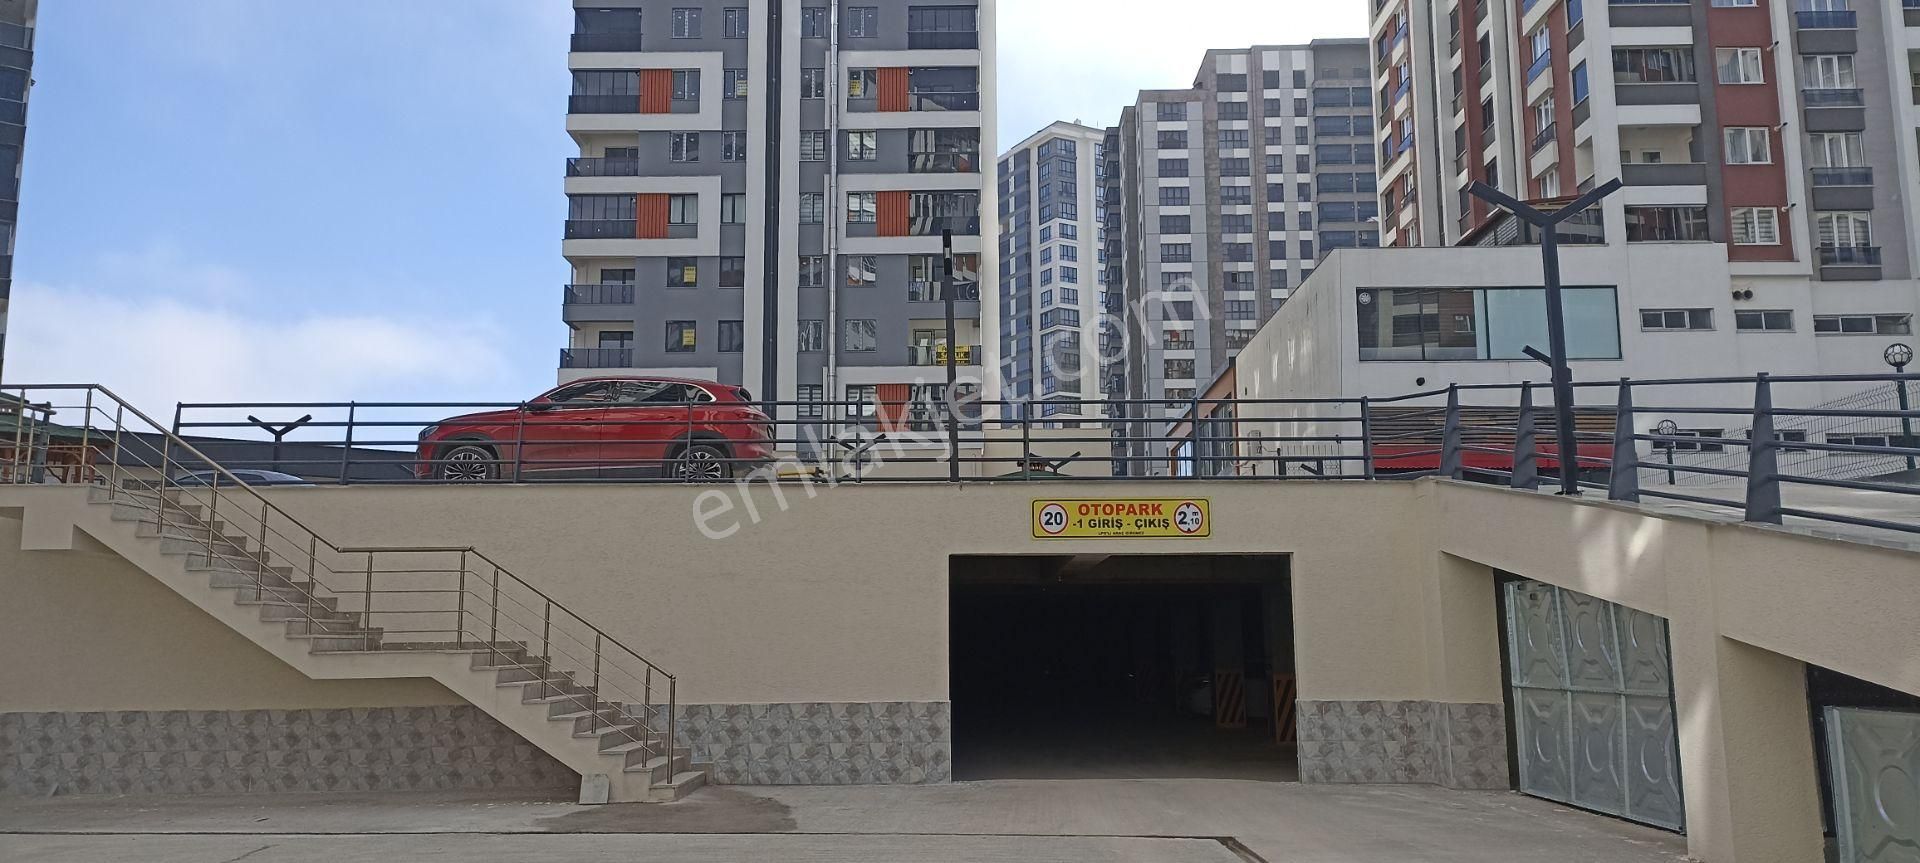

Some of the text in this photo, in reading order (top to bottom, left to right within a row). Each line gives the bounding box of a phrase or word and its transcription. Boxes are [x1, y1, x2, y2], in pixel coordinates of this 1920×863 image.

[1078, 503, 1163, 516] OTOPARK
[1044, 511, 1063, 526] 20
[1073, 518, 1083, 529] -1
[1088, 516, 1124, 531] GİRİŞ
[1134, 518, 1170, 531] ÇIKIŞ
